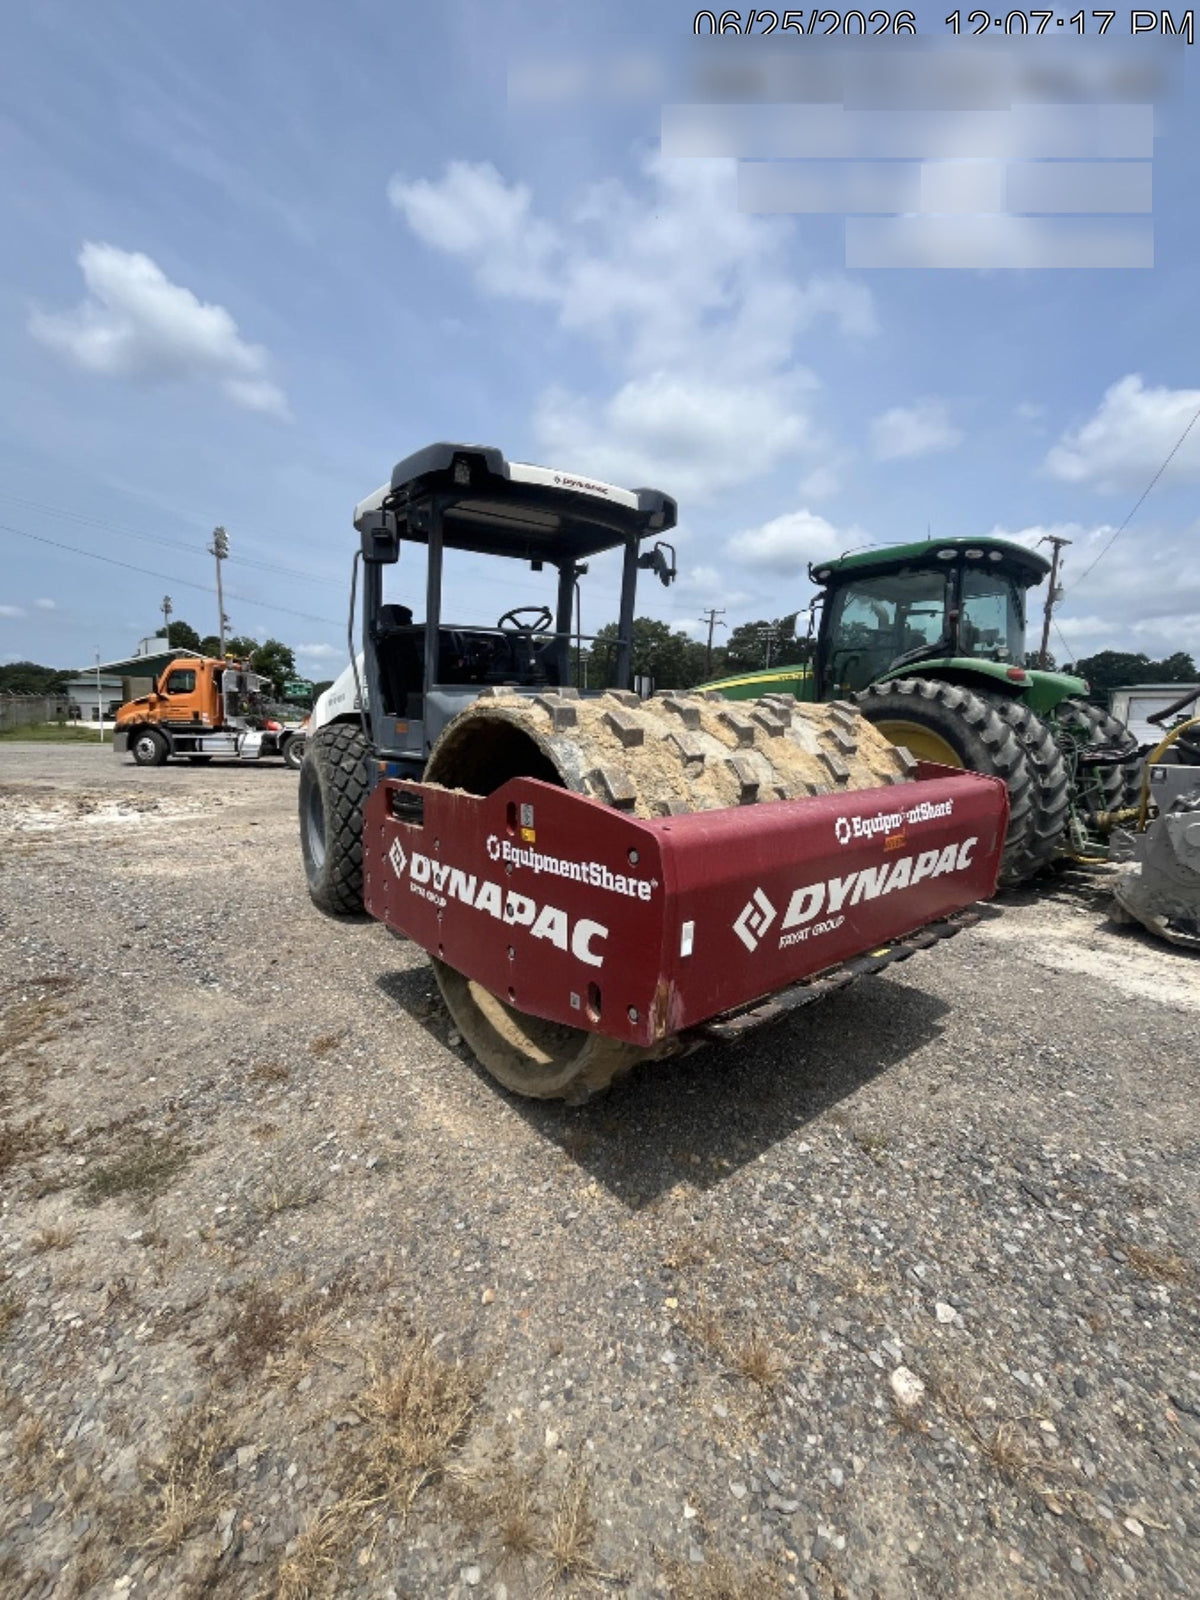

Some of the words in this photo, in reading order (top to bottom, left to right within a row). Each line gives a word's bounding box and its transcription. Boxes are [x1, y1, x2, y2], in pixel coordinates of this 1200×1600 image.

[852, 802, 952, 838] EquipmntShare
[410, 851, 609, 968] DYNAPAC
[780, 837, 978, 930] DYNAPAC
